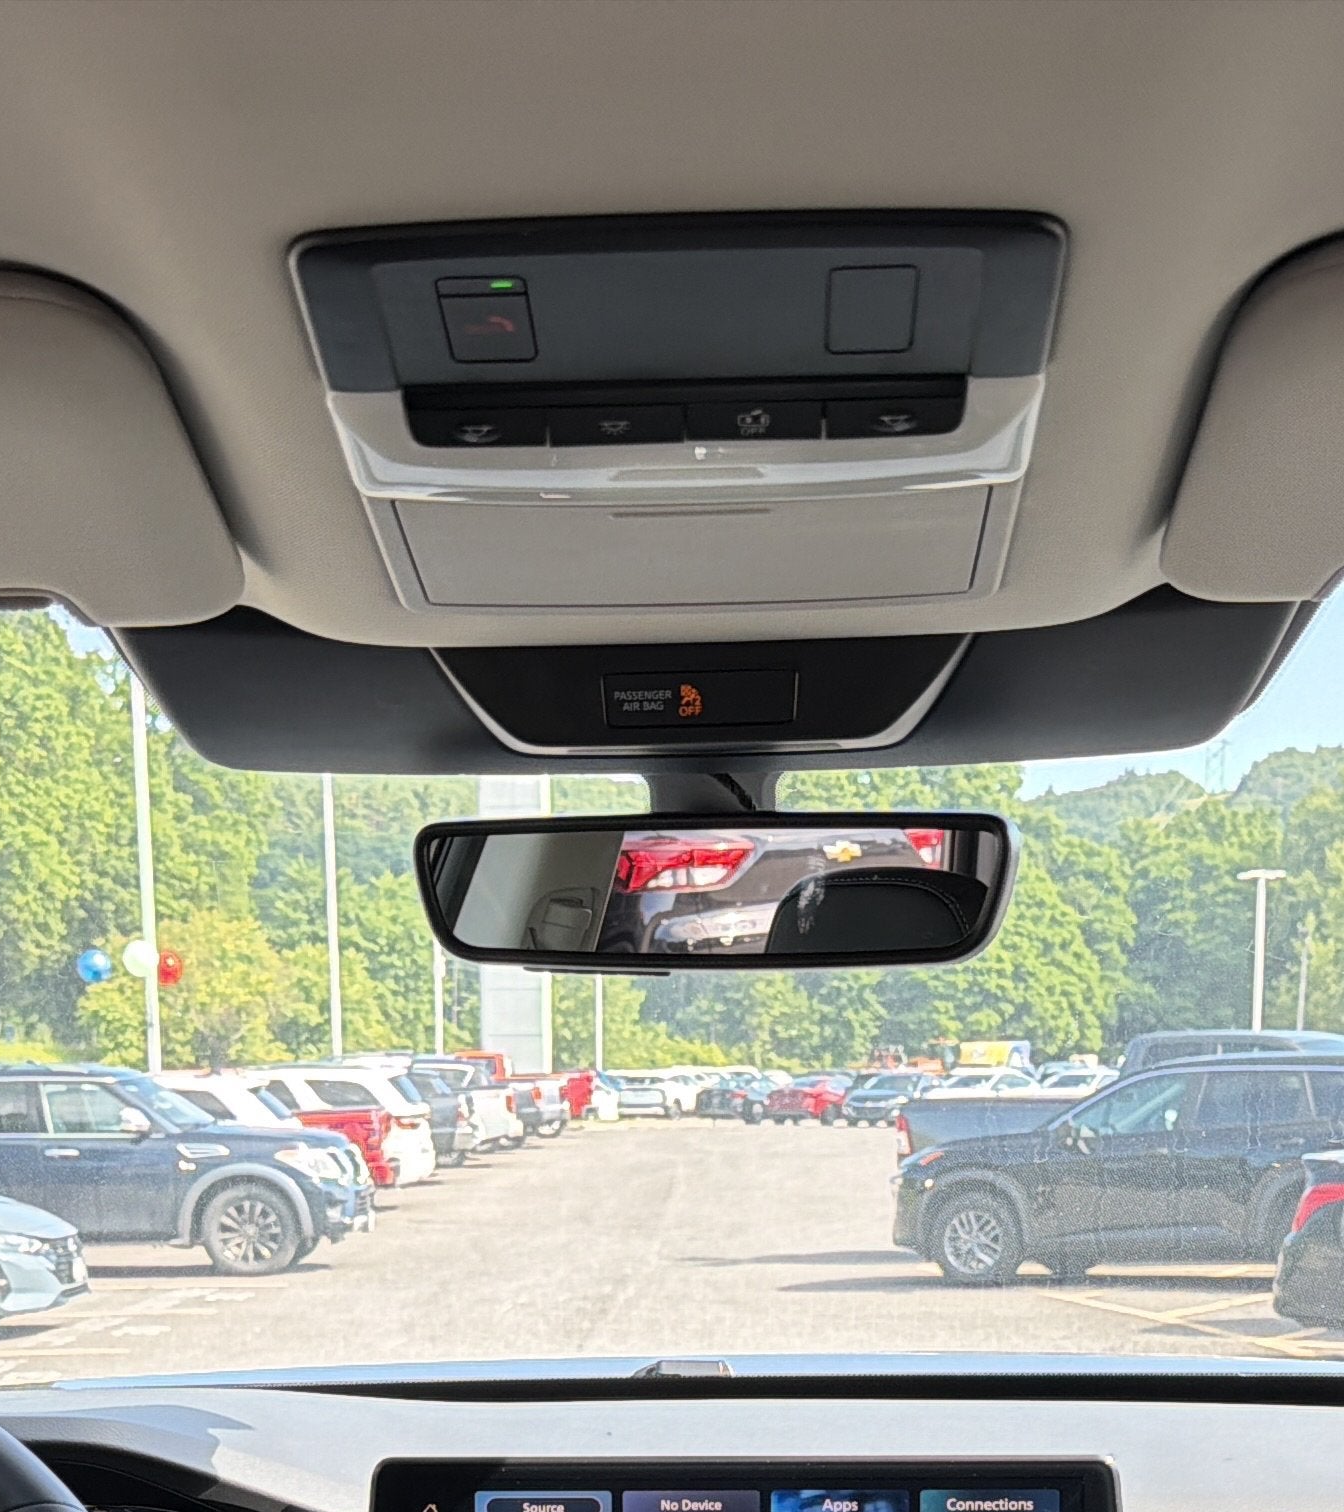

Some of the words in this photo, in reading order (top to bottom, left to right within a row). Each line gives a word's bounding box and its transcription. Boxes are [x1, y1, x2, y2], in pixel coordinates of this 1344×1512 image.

[614, 690, 672, 700] PASSENGER
[623, 702, 640, 711] AIR
[643, 701, 664, 711] BAG
[679, 706, 702, 716] OFF
[660, 1499, 678, 1511] No
[682, 1498, 722, 1511] Device
[946, 1498, 1034, 1511] Connections
